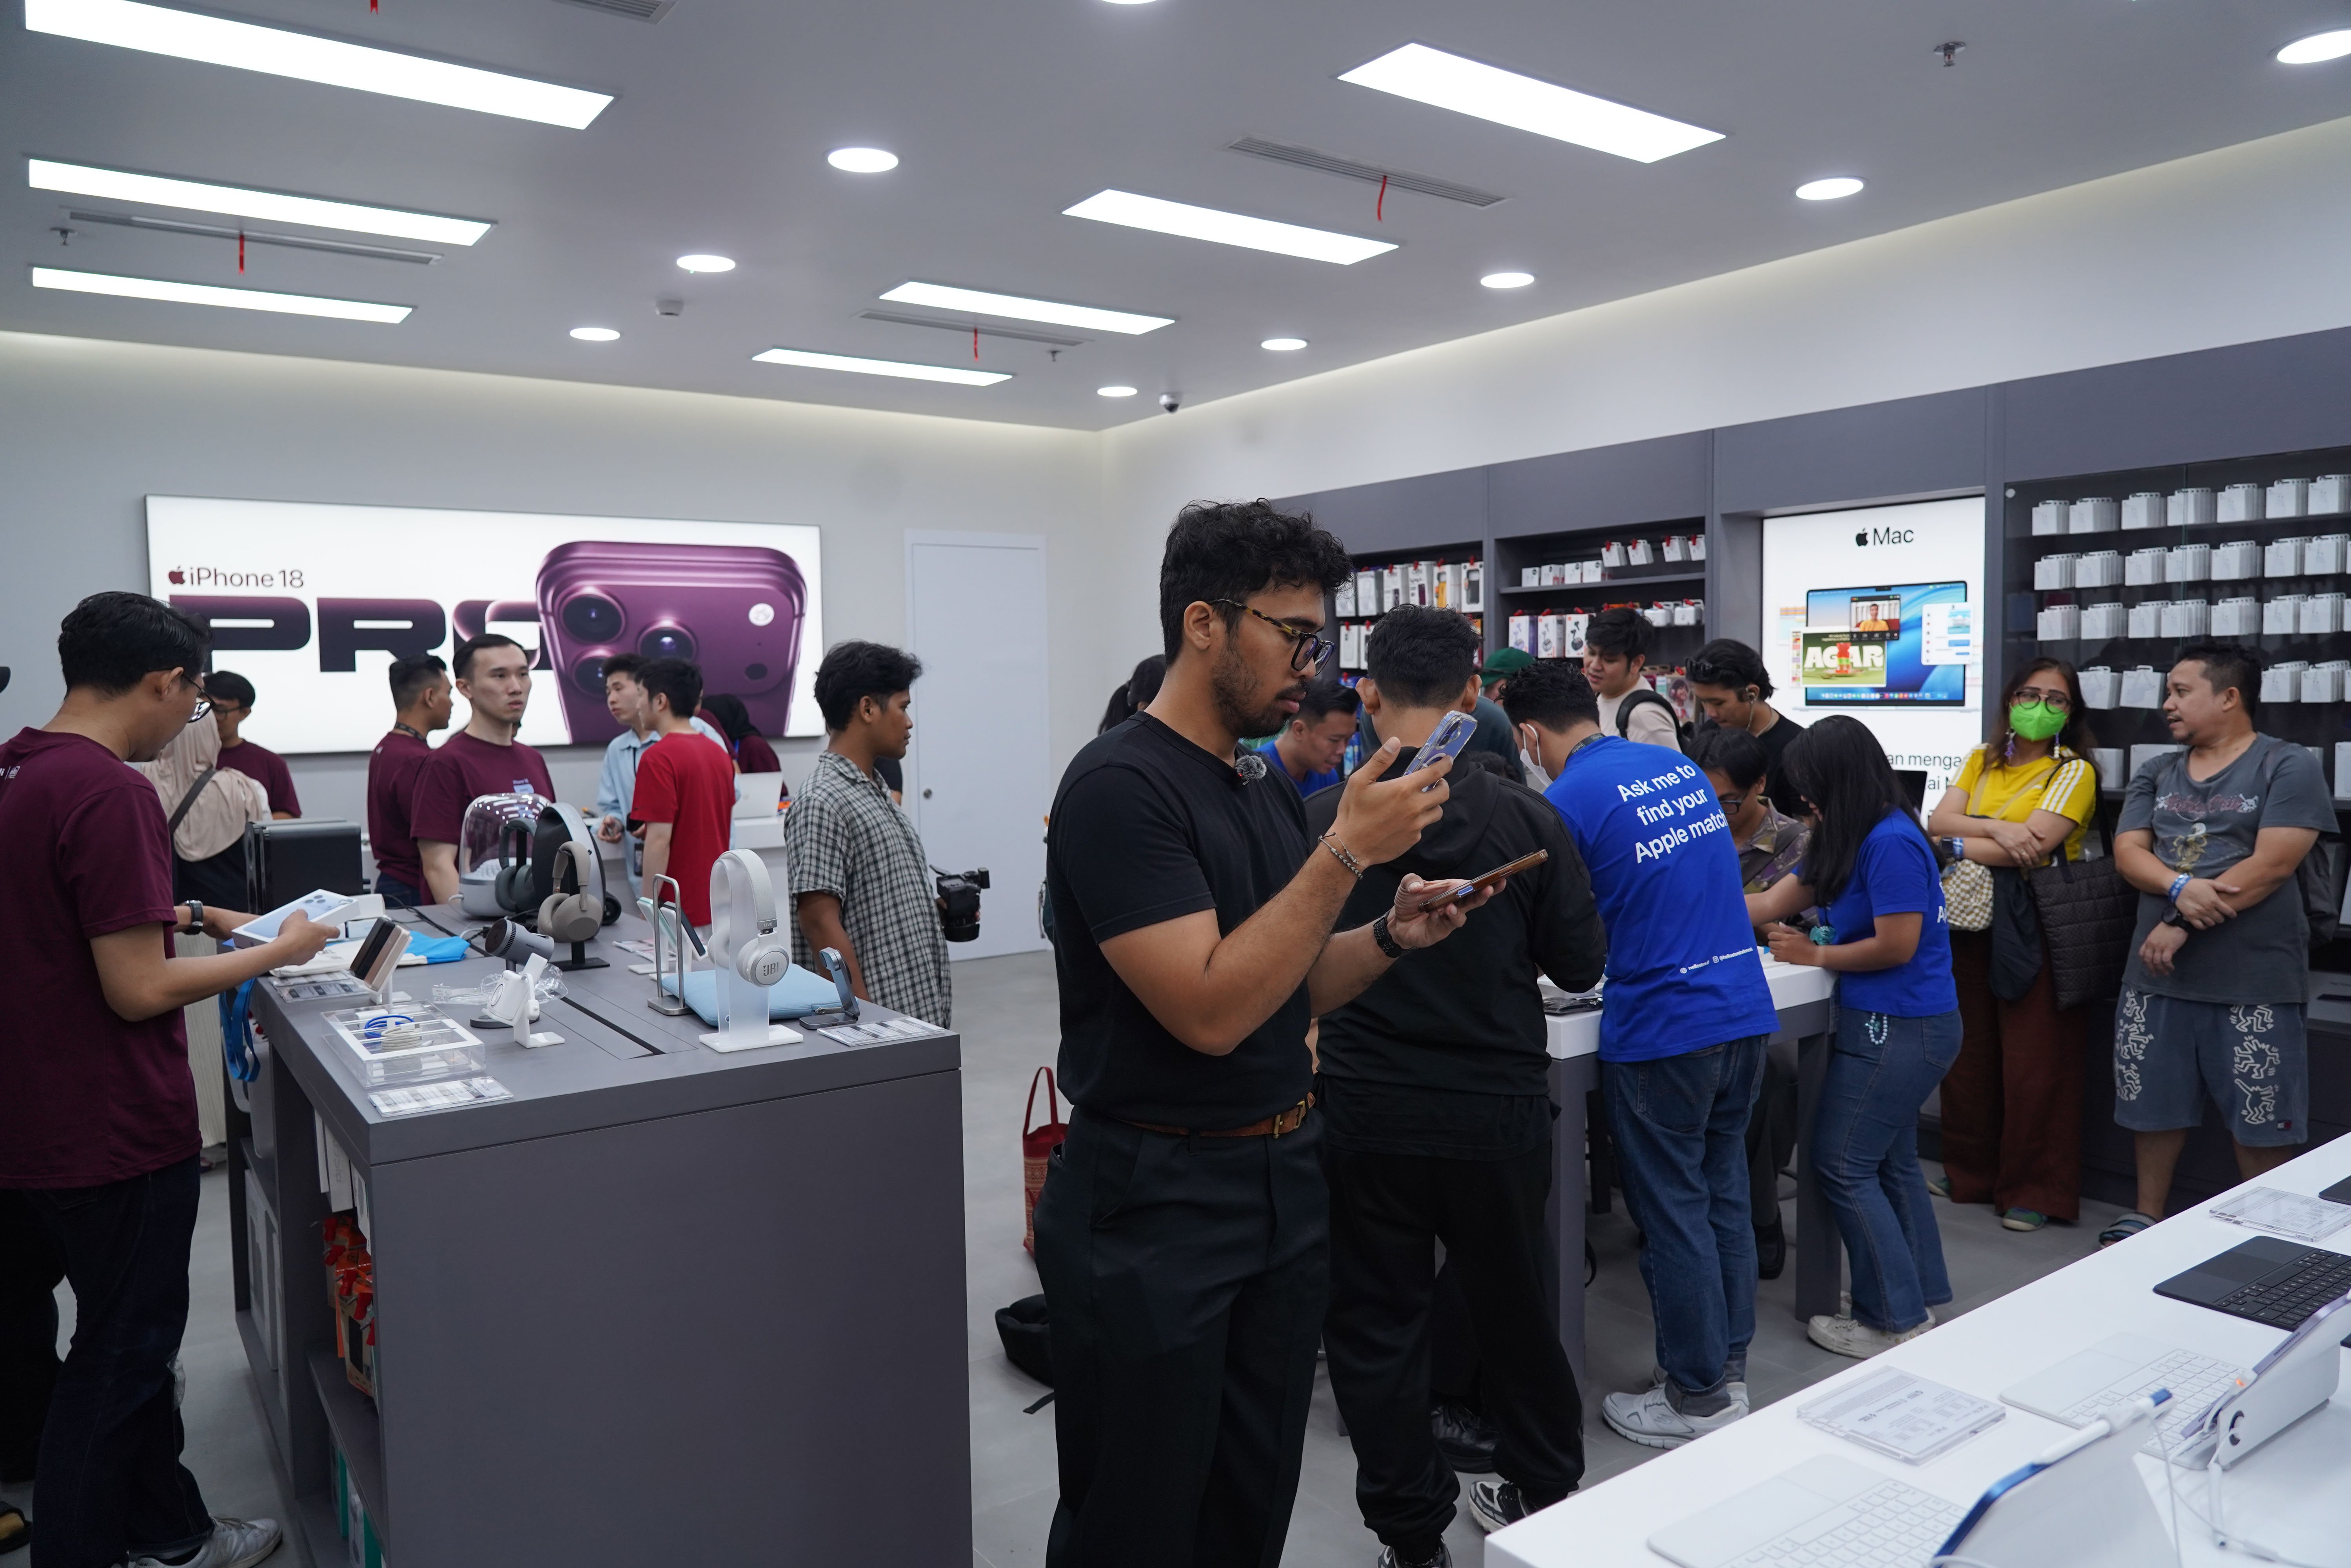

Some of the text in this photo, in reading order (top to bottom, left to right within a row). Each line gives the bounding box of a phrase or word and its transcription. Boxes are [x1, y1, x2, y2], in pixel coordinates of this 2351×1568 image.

[1873, 526, 1914, 546] Mac
[190, 567, 304, 588] iPhone 18
[1804, 645, 1884, 668] AGAR
[1617, 765, 1696, 802] Ask me to
[1636, 788, 1708, 826] find your
[1635, 809, 1729, 864] Apple match
[762, 962, 780, 976] JBL
